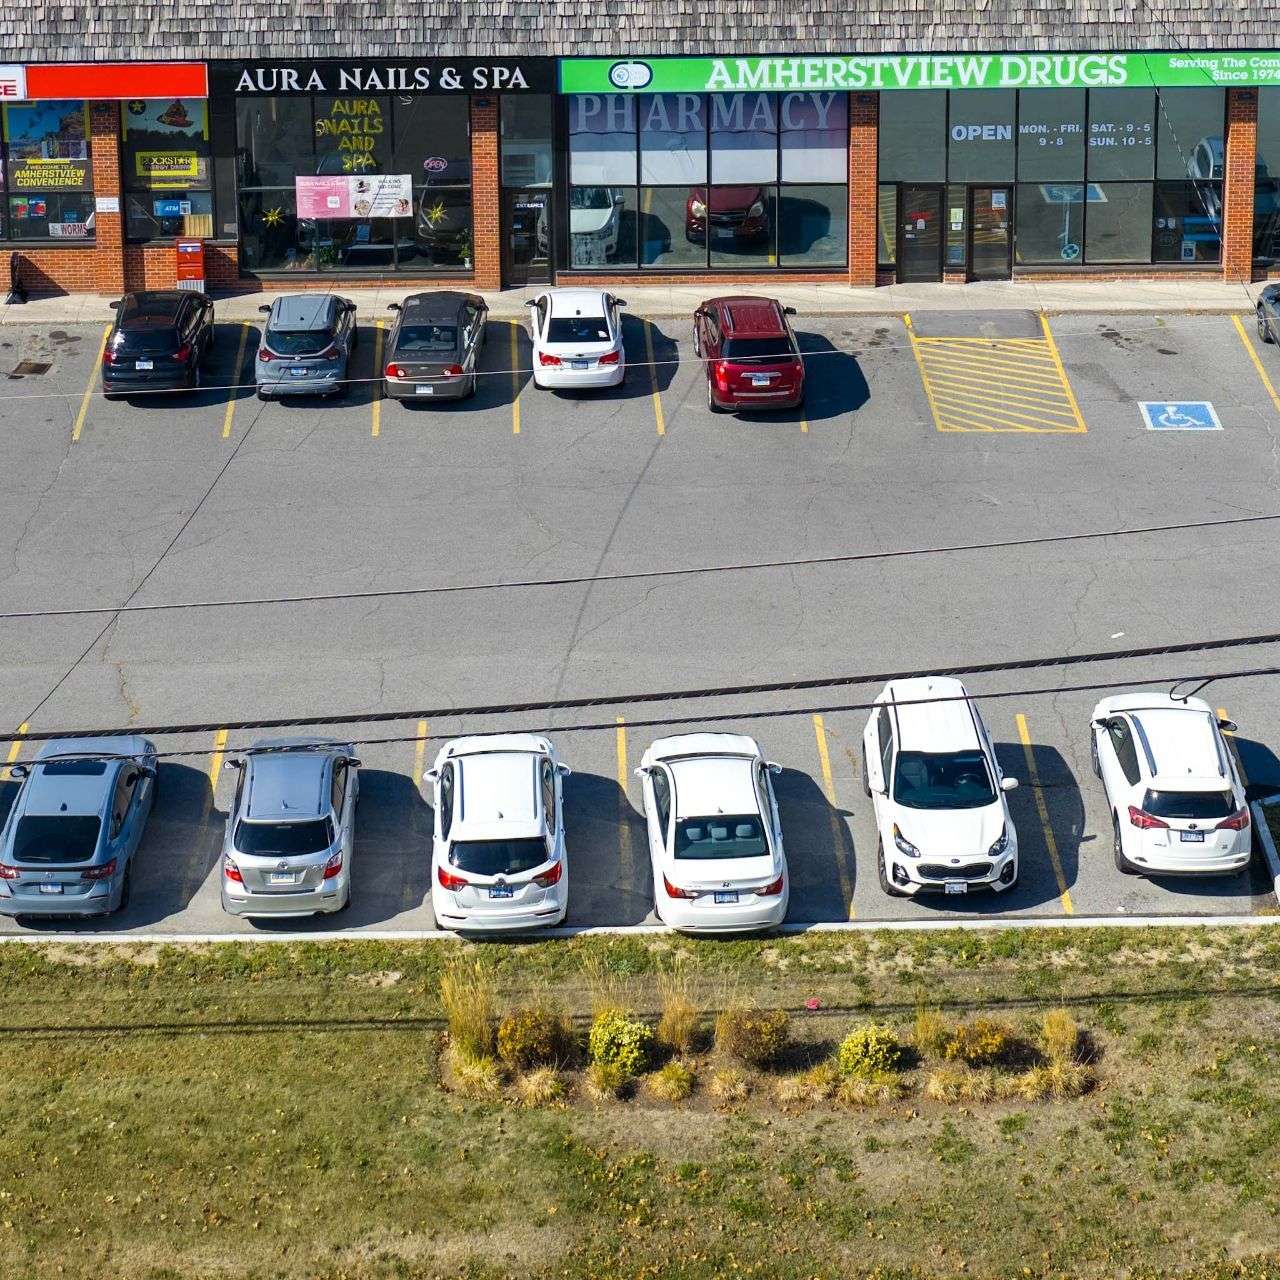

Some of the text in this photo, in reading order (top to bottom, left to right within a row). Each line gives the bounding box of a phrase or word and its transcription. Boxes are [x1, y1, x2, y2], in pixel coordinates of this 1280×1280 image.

[1169, 57, 1218, 69] Serving
[1222, 57, 1246, 67] The
[705, 55, 1128, 89] AMHERSTVIEW DRUGS
[1212, 70, 1248, 80] Since
[235, 66, 530, 91] AURA NAILS & SPA
[332, 99, 381, 116] AURA
[575, 93, 838, 131] PHARMACY
[325, 118, 384, 134] NAILS
[1019, 124, 1050, 133] MON.
[1060, 124, 1083, 133] FRI.
[1091, 123, 1116, 132] SAT.
[1126, 123, 1134, 132] 9
[1143, 123, 1151, 132] 5
[951, 125, 1012, 141] OPEN
[338, 136, 374, 152] AND
[1039, 138, 1046, 146] 9
[1056, 138, 1064, 146] 8
[1089, 137, 1118, 146] SUN.
[1121, 137, 1135, 145] 10
[1144, 137, 1152, 145] 5
[342, 153, 376, 170] SPA
[426, 160, 444, 169] OPEN
[14, 169, 86, 178] AMHERSTVIEW
[17, 178, 84, 186] CONVENIENCE
[61, 223, 88, 235] WORMS
